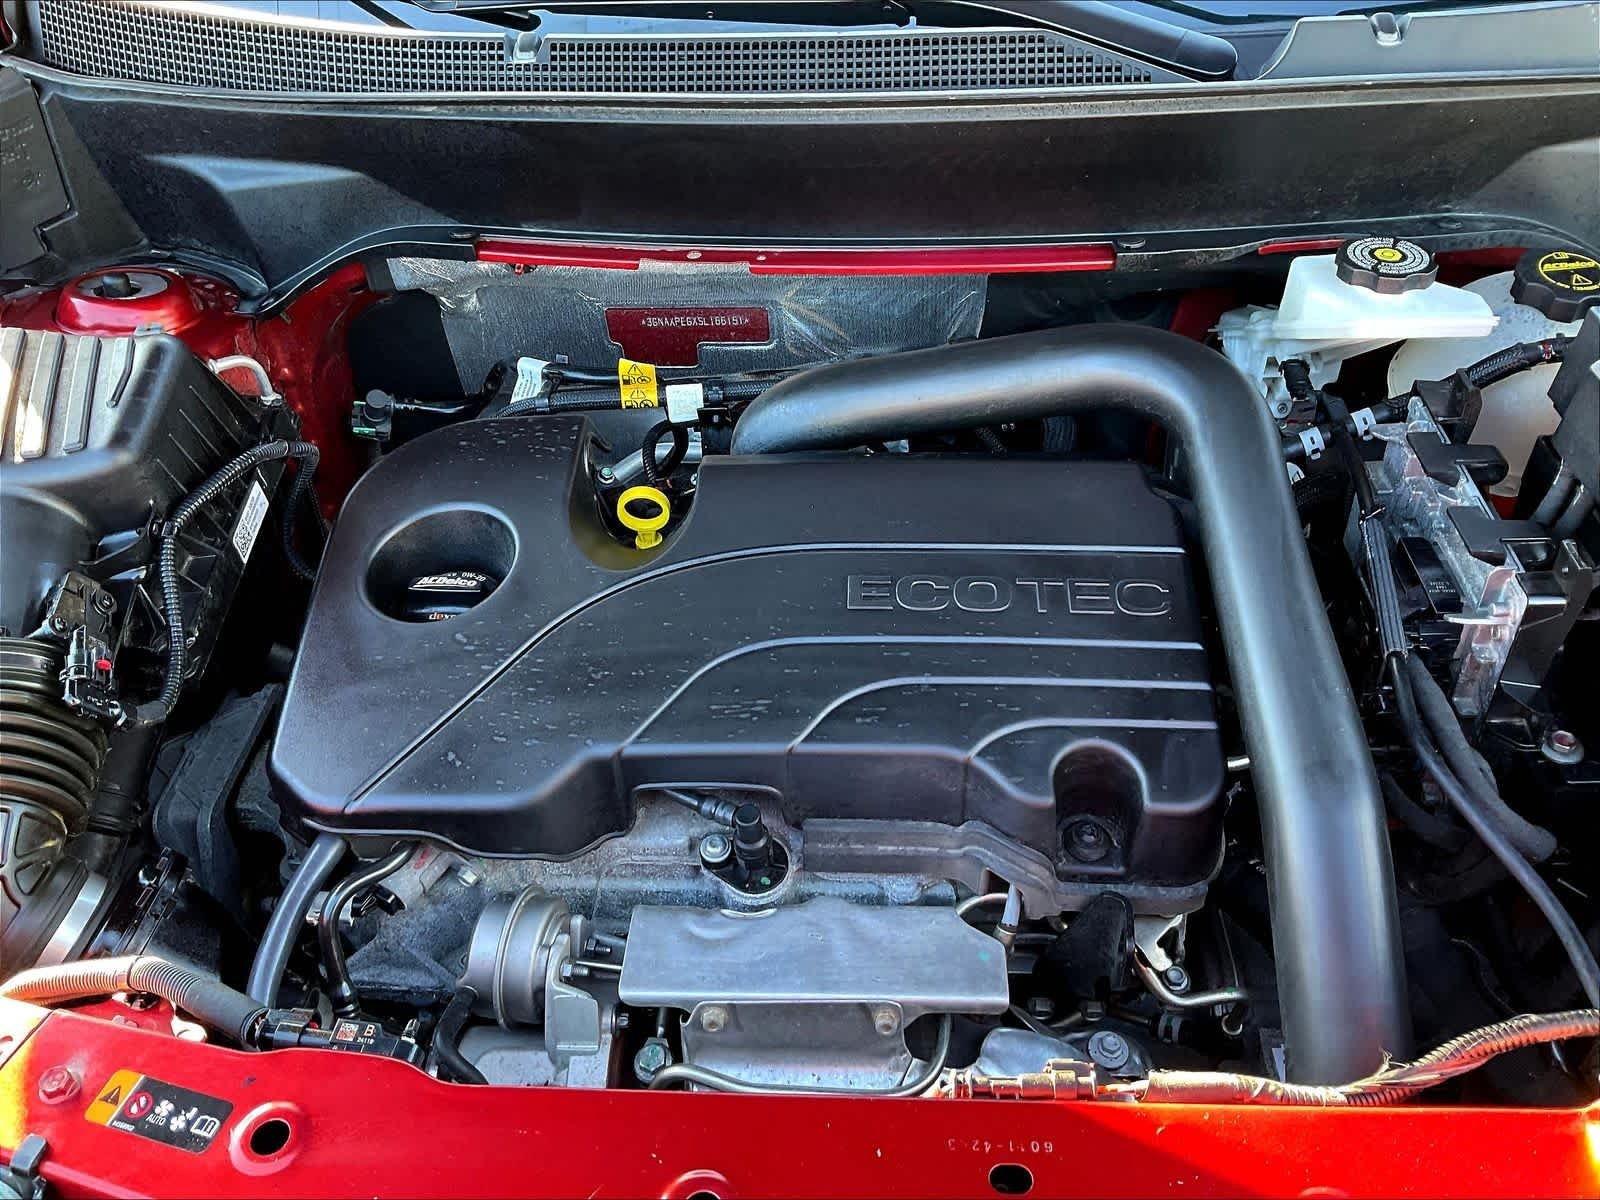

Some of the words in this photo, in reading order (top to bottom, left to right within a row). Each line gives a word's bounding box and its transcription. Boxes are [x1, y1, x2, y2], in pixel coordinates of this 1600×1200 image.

[415, 576, 477, 587] ACDelco
[461, 571, 487, 582] 0W-20
[846, 575, 1170, 616] ECOTEC
[145, 1113, 168, 1126] AUTO
